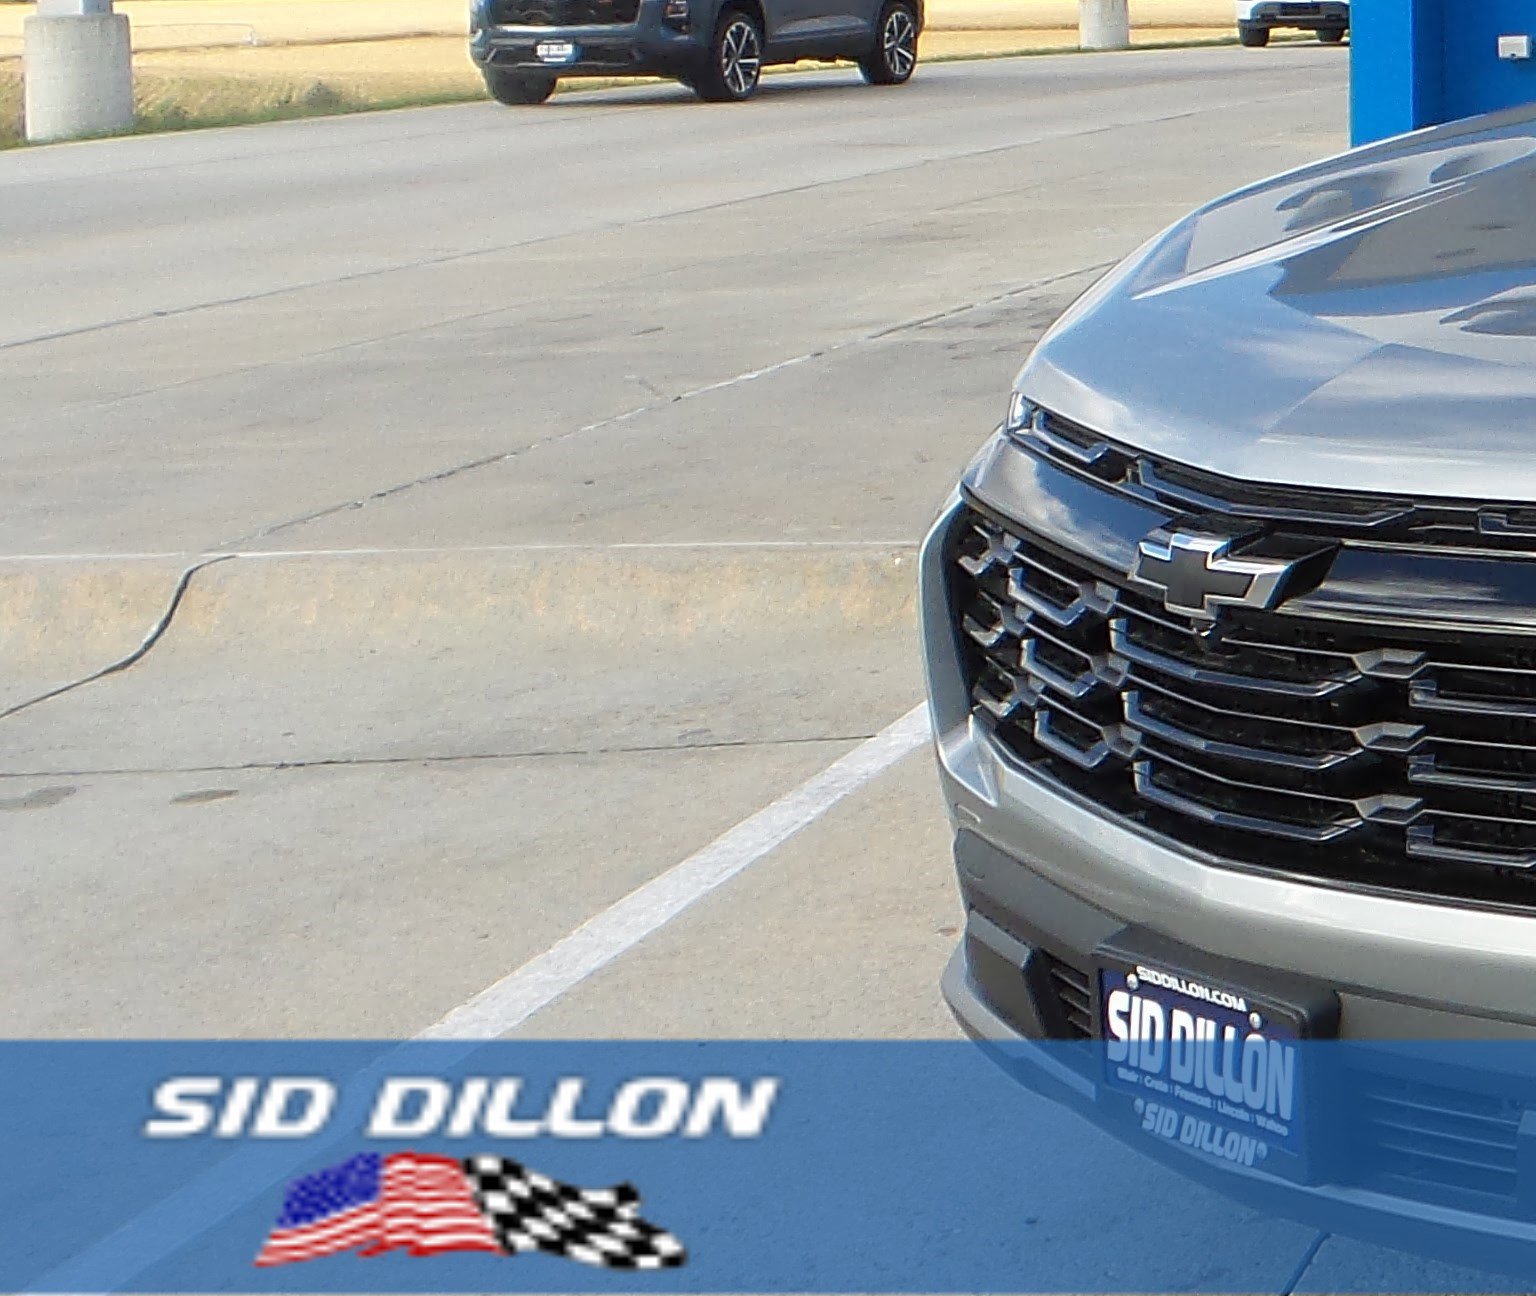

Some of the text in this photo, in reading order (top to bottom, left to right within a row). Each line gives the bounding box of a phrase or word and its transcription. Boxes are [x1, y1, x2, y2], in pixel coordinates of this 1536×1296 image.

[1136, 965, 1248, 1012] SIDDILLON.COM
[1107, 990, 1295, 1121] SID DILLON
[1142, 1103, 1258, 1167] SID DILLON
